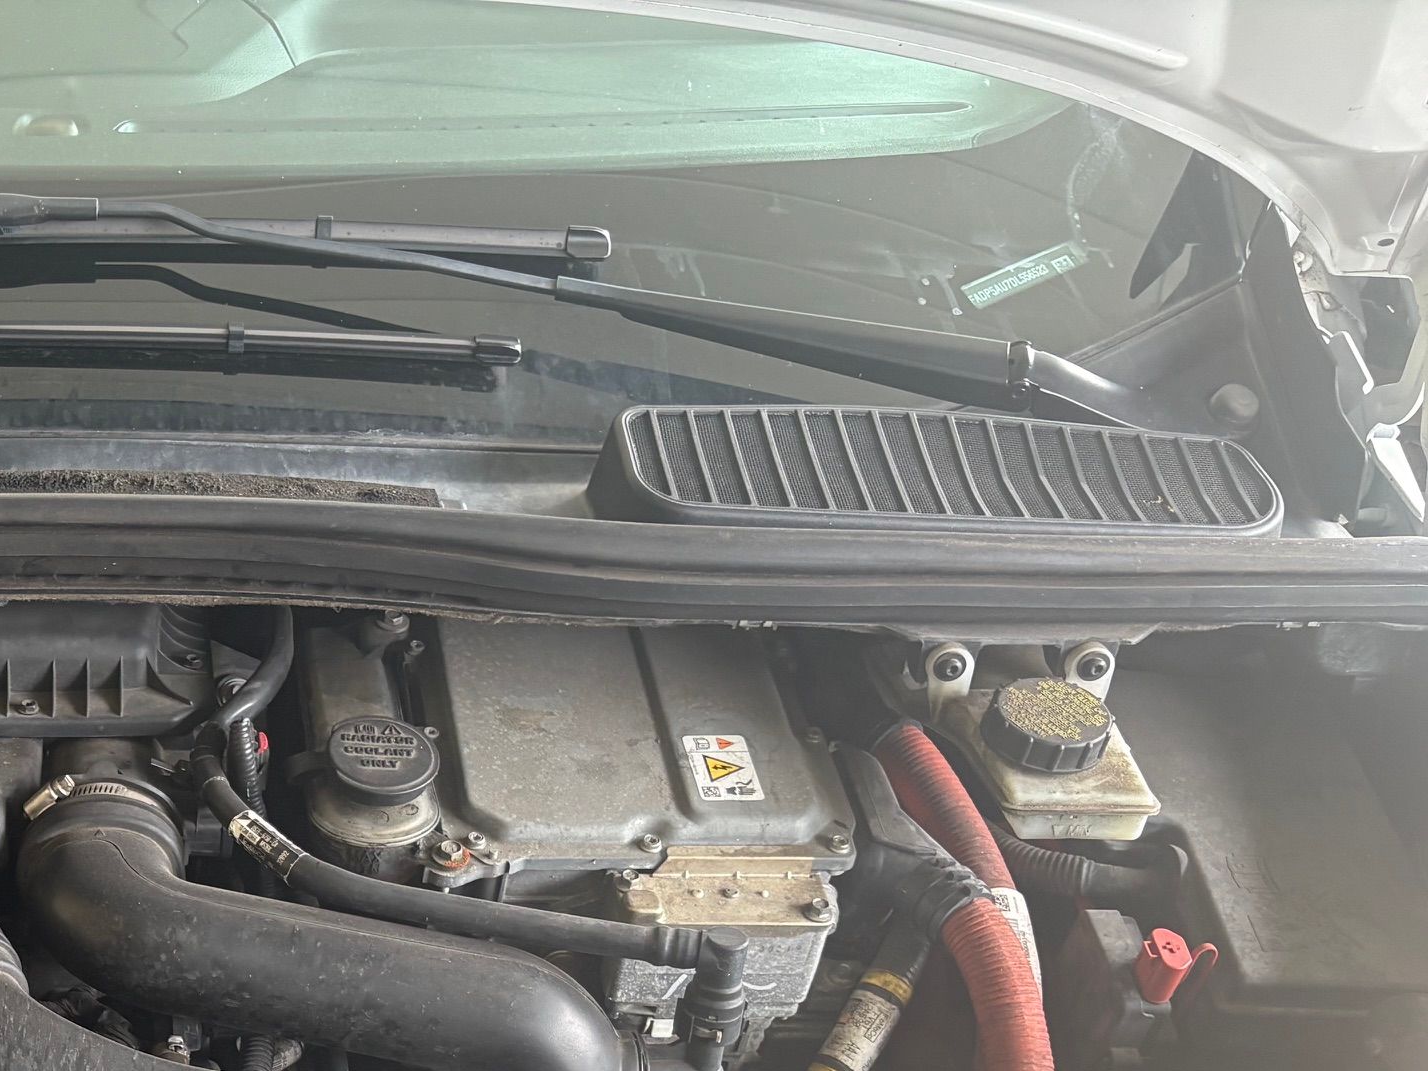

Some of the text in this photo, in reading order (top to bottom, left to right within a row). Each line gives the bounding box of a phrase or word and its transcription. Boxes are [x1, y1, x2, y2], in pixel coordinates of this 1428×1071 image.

[340, 732, 416, 745] RADIATOR
[343, 746, 416, 758] COOLANT
[359, 759, 401, 770] ONLY
